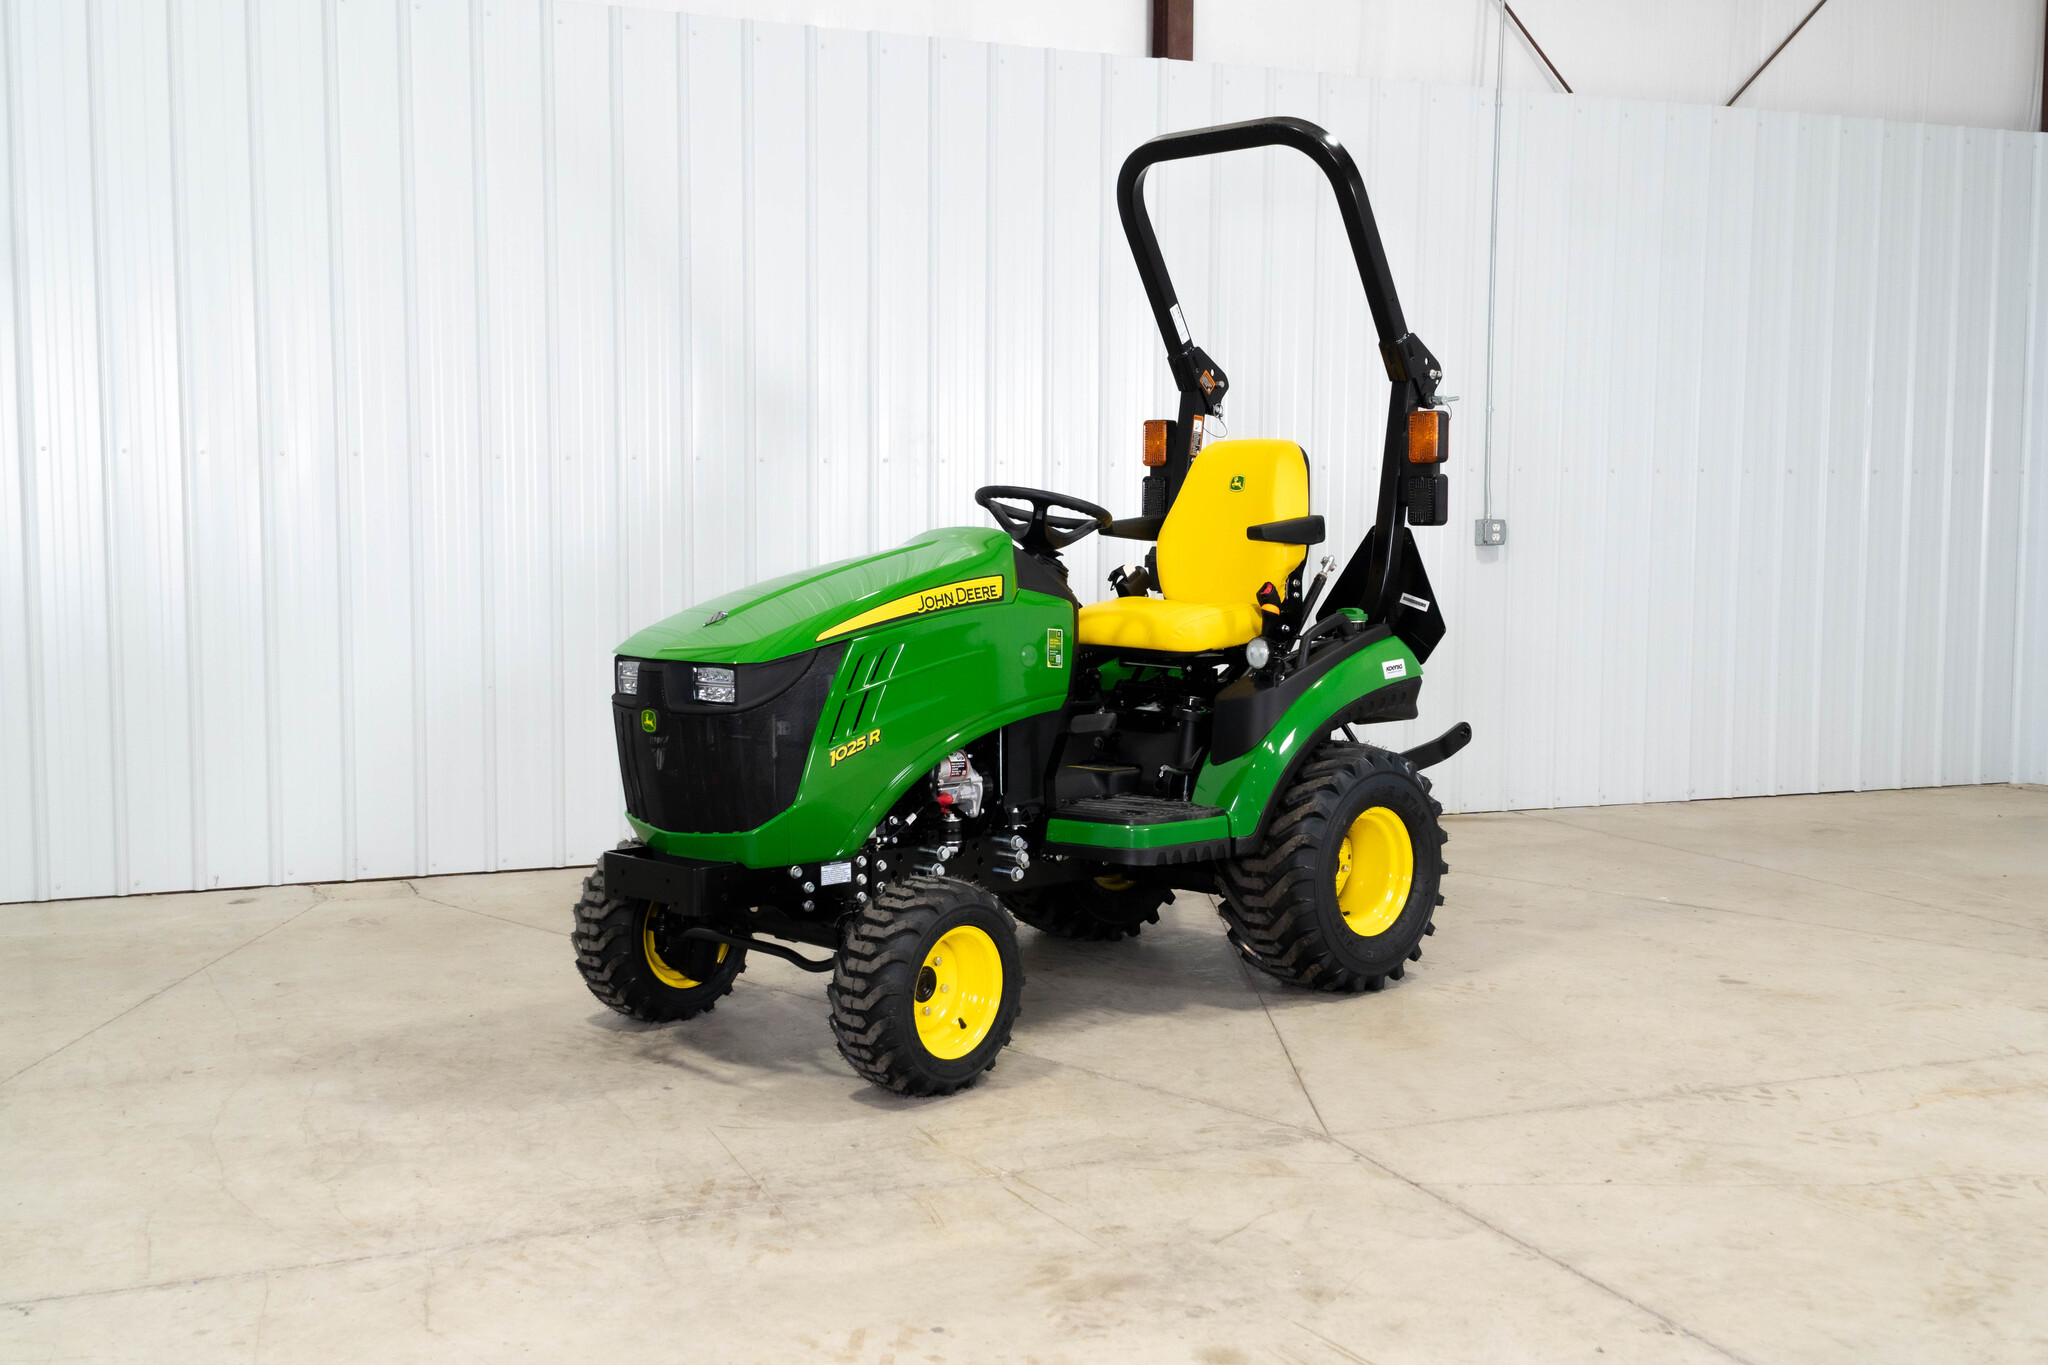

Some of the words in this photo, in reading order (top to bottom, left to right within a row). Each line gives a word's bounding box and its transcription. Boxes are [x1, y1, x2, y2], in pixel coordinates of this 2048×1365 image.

[918, 592, 954, 611] JOHN
[956, 585, 997, 602] DEERE
[830, 735, 867, 768] 1025
